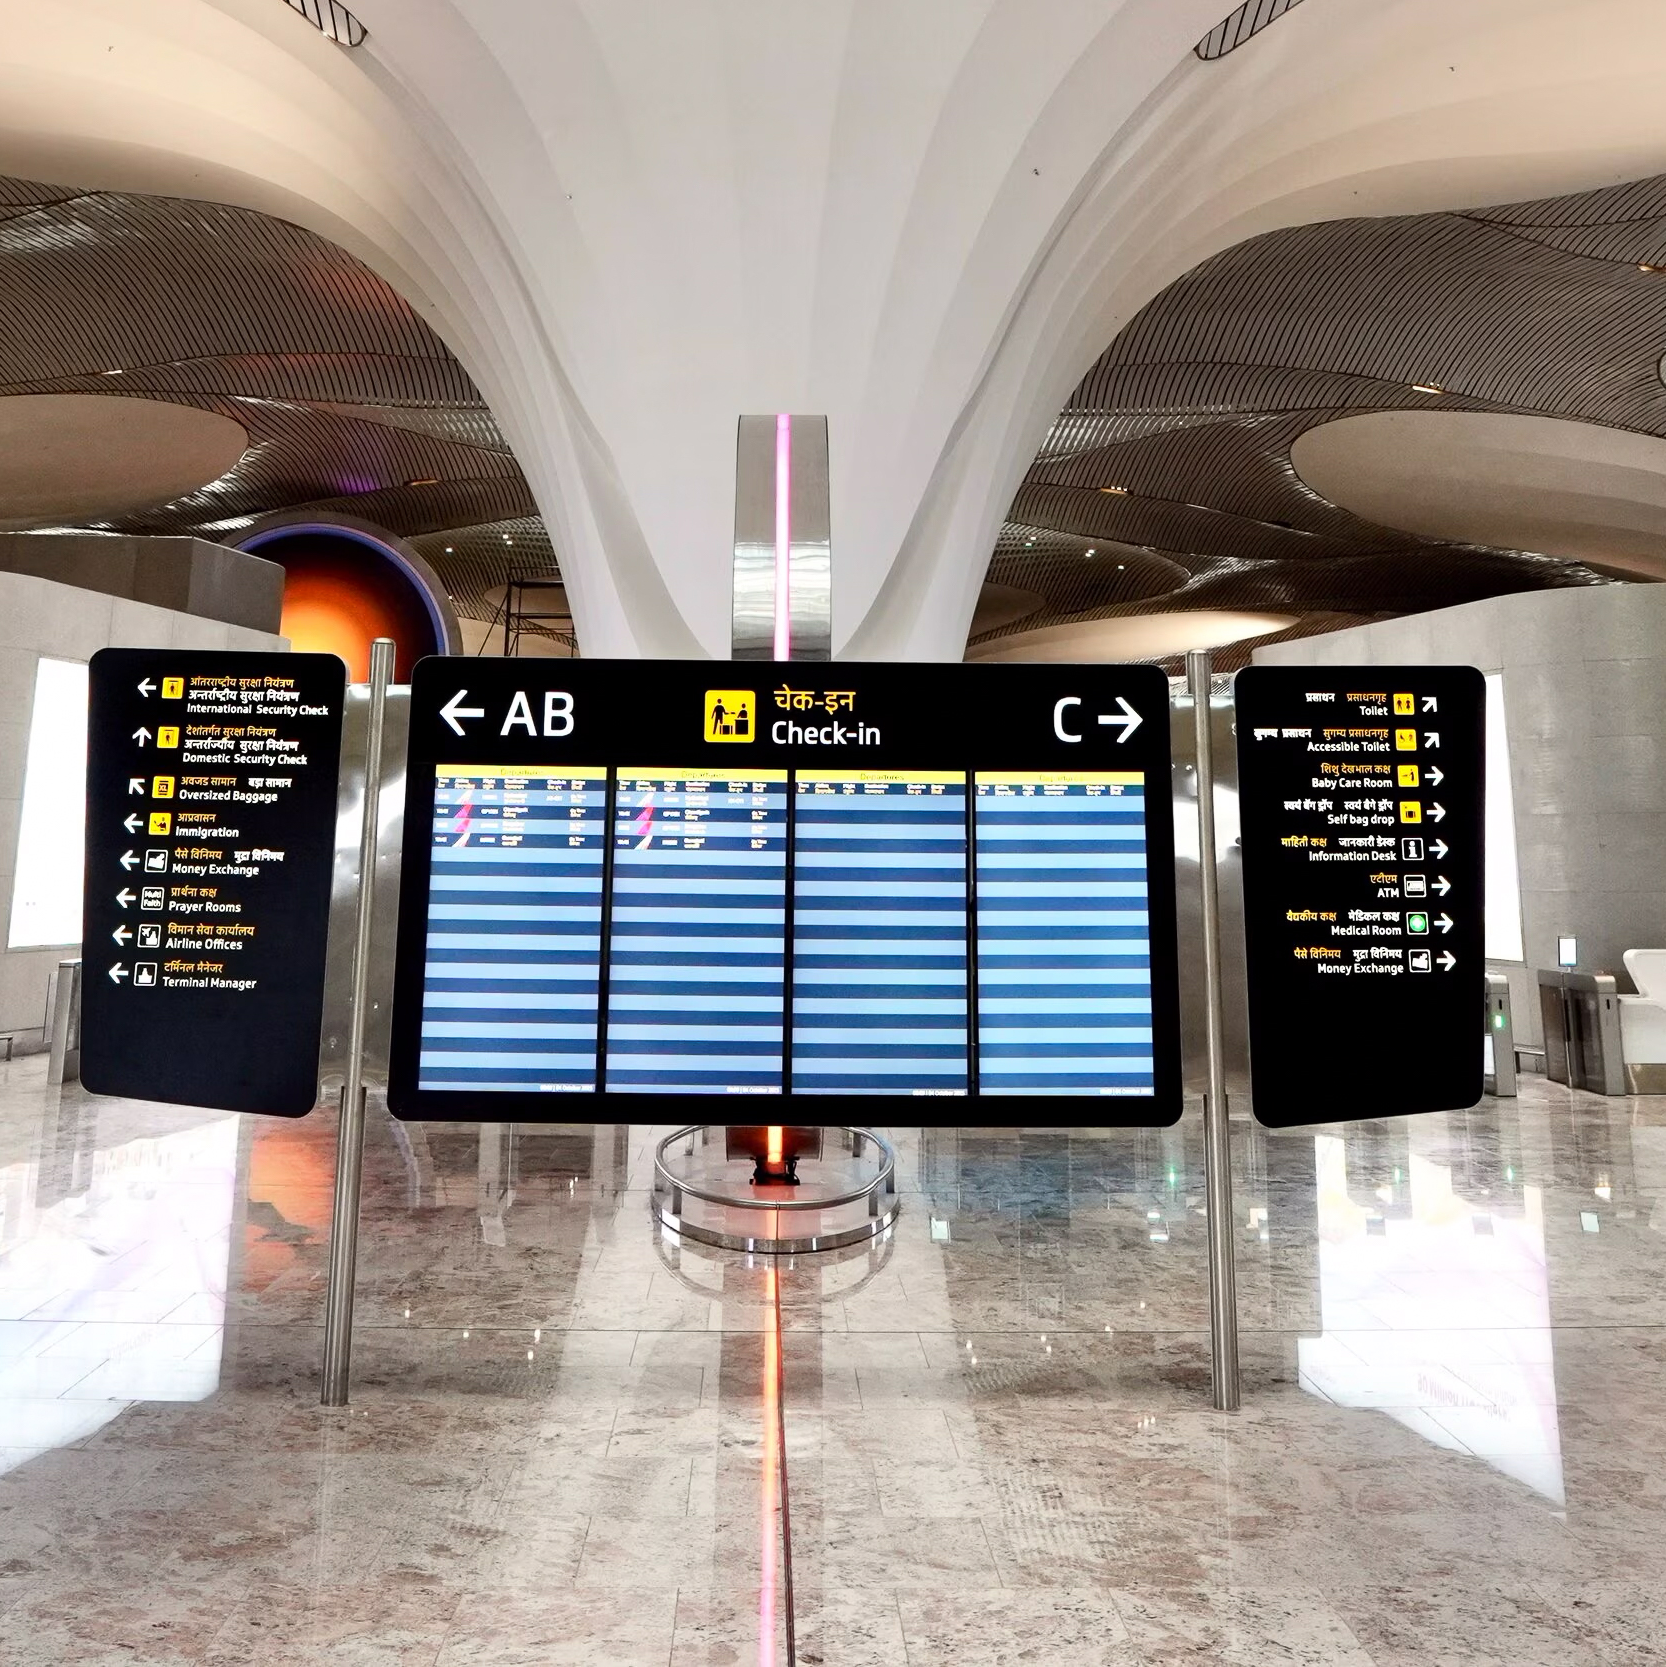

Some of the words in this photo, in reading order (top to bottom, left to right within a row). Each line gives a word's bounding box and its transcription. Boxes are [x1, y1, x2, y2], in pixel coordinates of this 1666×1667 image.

[239, 678, 261, 690] सुरक्षा
[264, 677, 294, 688] नियंत्रण
[773, 684, 855, 714] चेक-इन
[187, 703, 252, 714] International
[256, 704, 297, 717] Security
[299, 705, 328, 716] Check
[501, 691, 575, 737] AB
[1359, 706, 1388, 715] Toilet
[1053, 696, 1082, 742] C
[771, 718, 880, 746] Check-in
[1307, 742, 1359, 751] Accessible
[1361, 742, 1390, 751] Toilet
[183, 752, 230, 764] Domestic
[233, 754, 276, 766] Security
[277, 754, 307, 765] Check
[1312, 778, 1337, 790] Baby
[1339, 778, 1361, 788] Care
[1363, 778, 1392, 788] Room
[179, 789, 231, 800] Oversized
[233, 791, 278, 803] Baggage
[1327, 814, 1348, 824] Self
[1350, 814, 1368, 826] bag
[1371, 814, 1394, 826] drop
[175, 826, 239, 839] Immigration
[1309, 851, 1369, 861] Information
[1371, 851, 1397, 861] Desk
[172, 863, 207, 876] Money
[209, 864, 259, 877] Exchange
[1377, 888, 1399, 897] ATM
[168, 901, 203, 914] Prayer
[205, 902, 241, 912] Rooms
[1331, 925, 1370, 935] Medical
[1372, 925, 1401, 935] Room
[165, 938, 202, 949] Airline
[205, 938, 242, 950] Offices
[1318, 963, 1352, 975] Money
[1354, 963, 1403, 975] Exchange
[162, 976, 208, 988] Terminal
[210, 977, 257, 991] Manager
